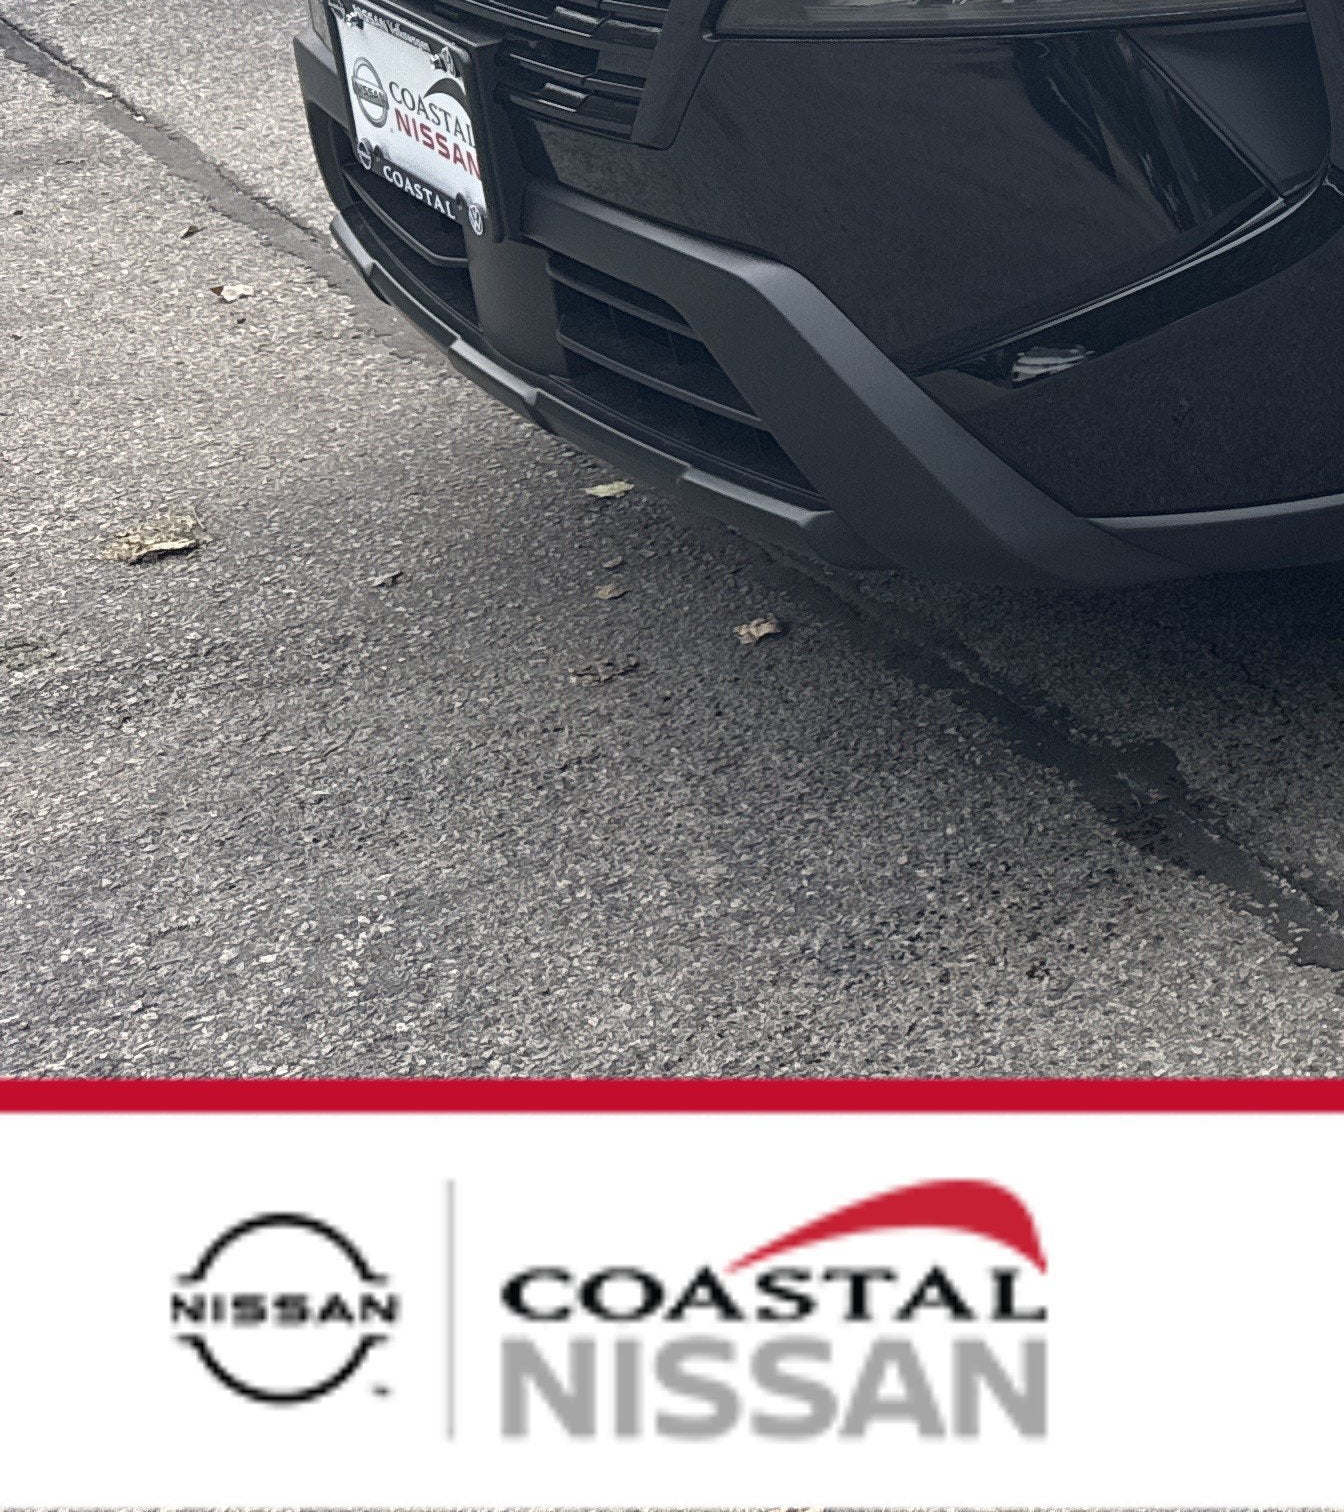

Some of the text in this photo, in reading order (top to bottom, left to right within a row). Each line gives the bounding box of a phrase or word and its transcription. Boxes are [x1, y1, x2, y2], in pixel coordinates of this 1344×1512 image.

[389, 81, 476, 149] COASTAL
[394, 107, 482, 181] NISSAN
[383, 165, 456, 219] COASTAL
